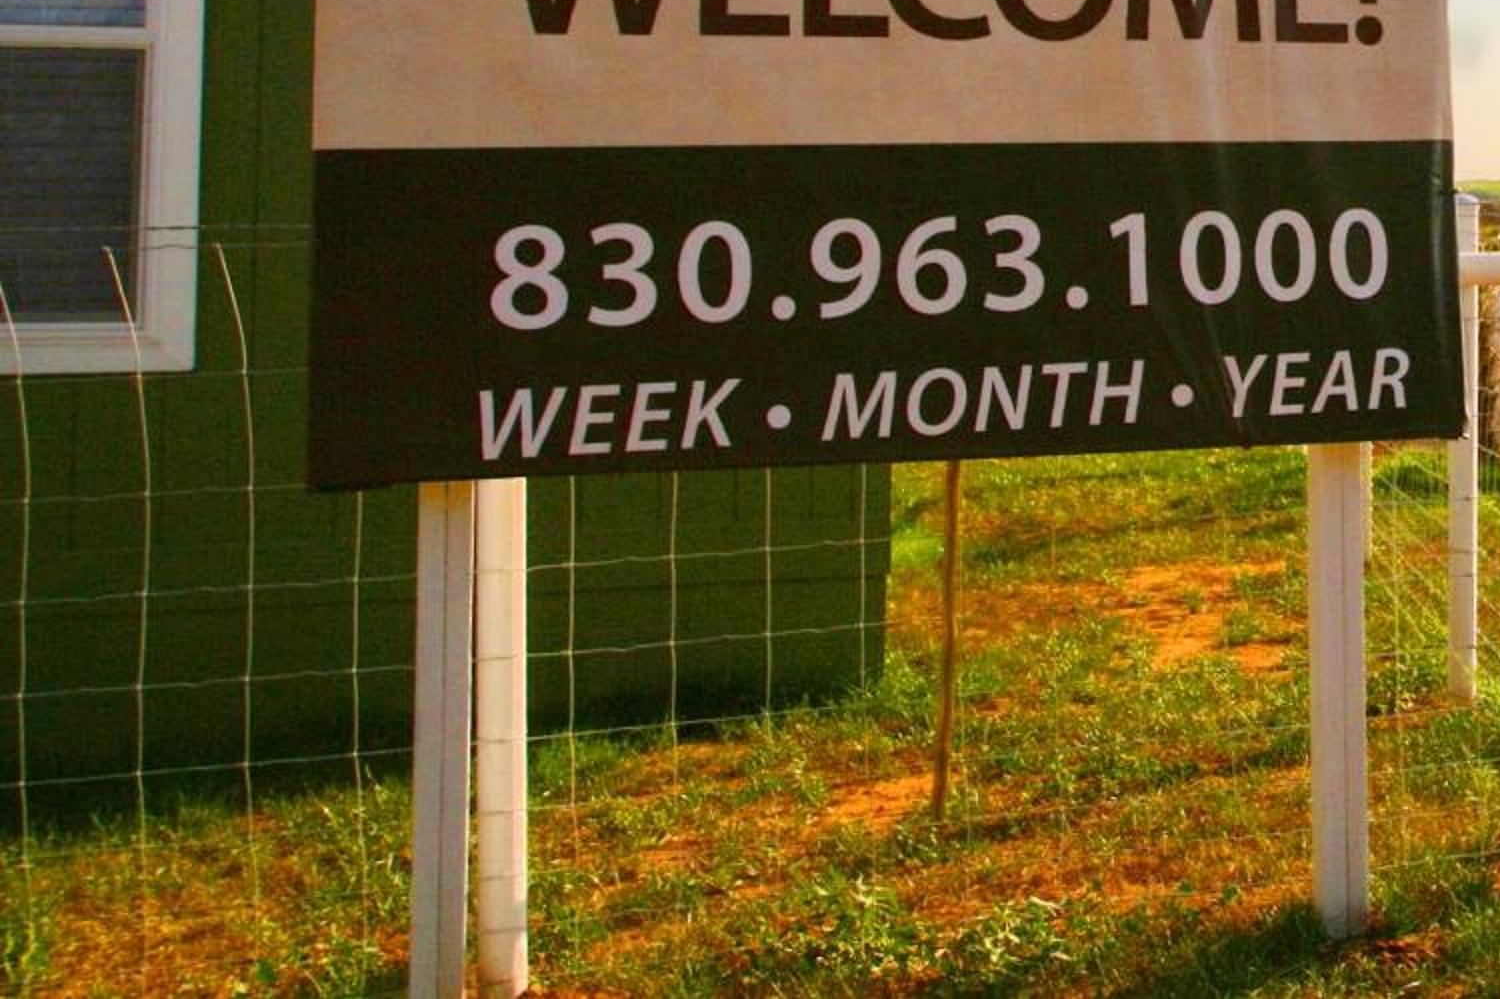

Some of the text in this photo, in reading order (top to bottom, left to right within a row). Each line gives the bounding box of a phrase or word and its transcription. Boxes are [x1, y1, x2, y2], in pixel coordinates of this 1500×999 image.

[490, 208, 1389, 330] 830.963.1000
[478, 347, 1412, 461] WEEK MONTH YEAR
